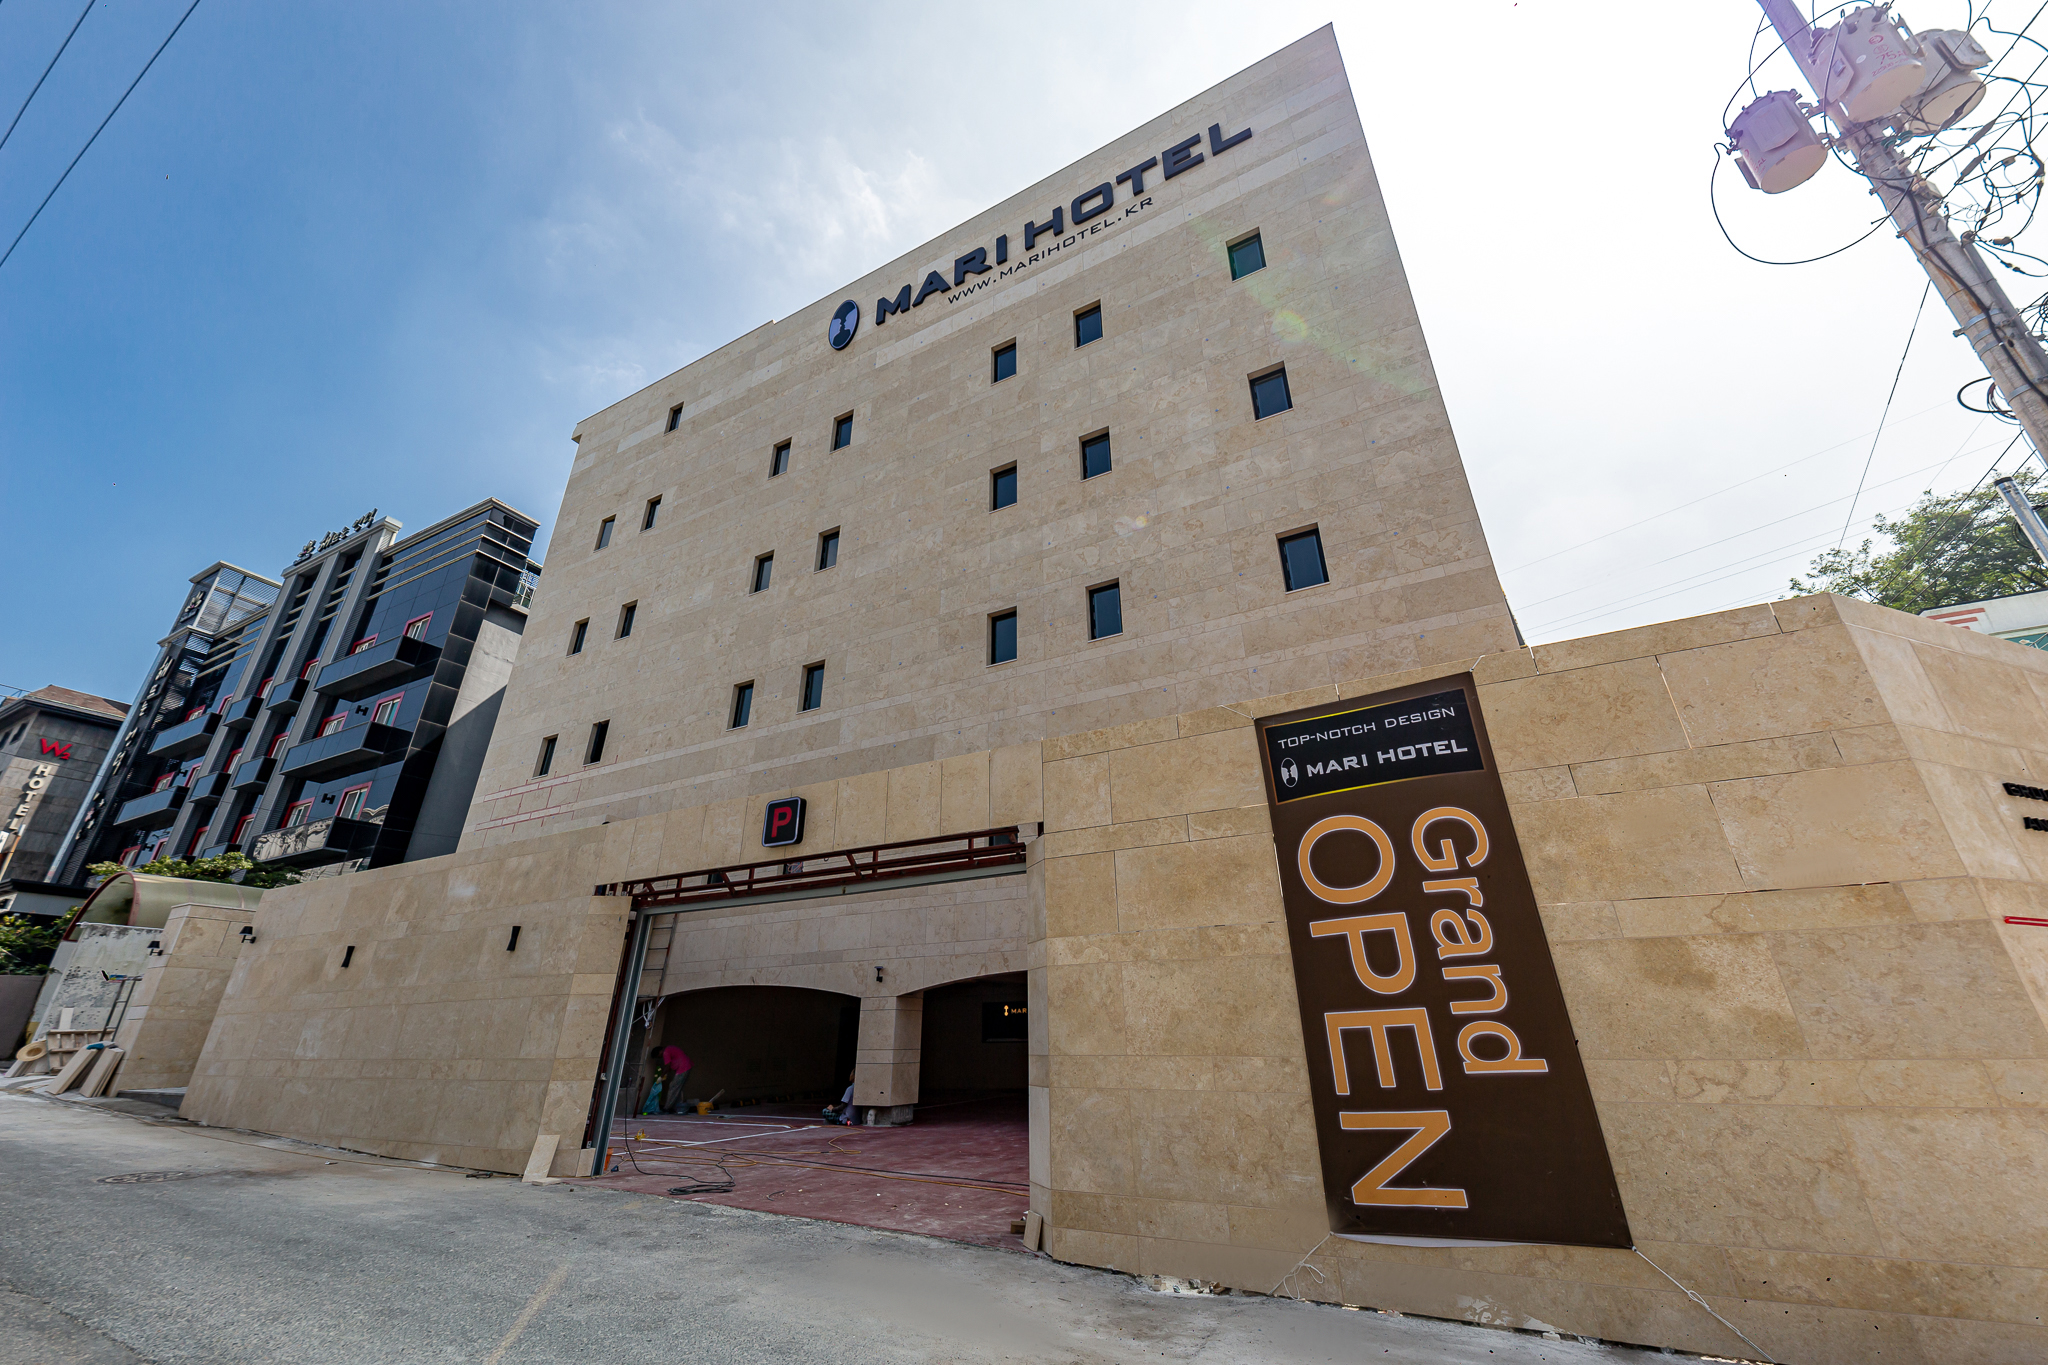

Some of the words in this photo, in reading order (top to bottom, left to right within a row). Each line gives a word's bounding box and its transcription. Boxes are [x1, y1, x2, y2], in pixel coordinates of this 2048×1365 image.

[875, 233, 1008, 326] MARI
[1023, 122, 1253, 251] HOTEL
[947, 197, 1154, 305] WWW.MARIHOTEL.KR
[1277, 722, 1376, 749] TOP-NOTCH
[1384, 706, 1455, 729] DESIGN
[1306, 754, 1369, 777] MARI
[1376, 739, 1468, 764] HOTEL
[9, 764, 51, 831] HOTEL
[771, 806, 793, 838] P
[1411, 806, 1549, 1074] Grand
[1298, 814, 1469, 1209] OPEN
